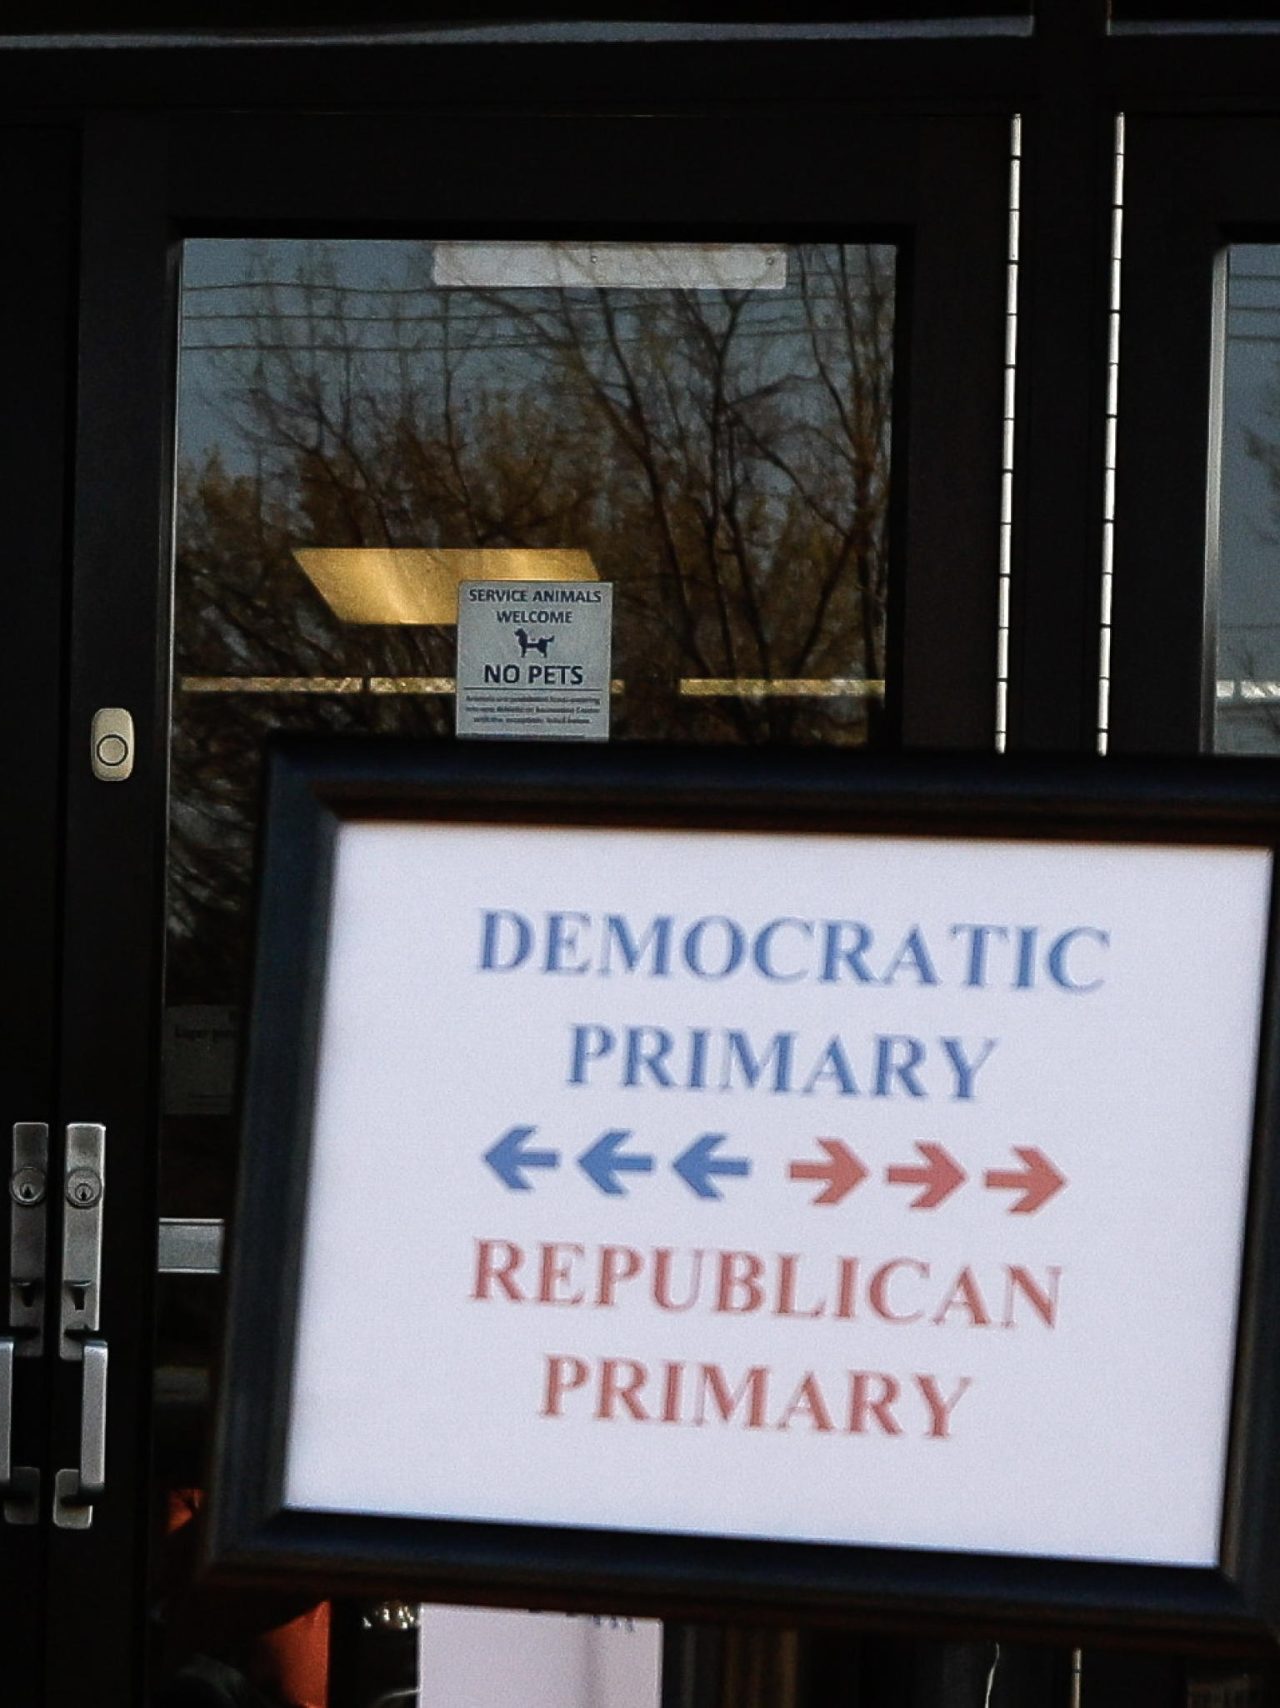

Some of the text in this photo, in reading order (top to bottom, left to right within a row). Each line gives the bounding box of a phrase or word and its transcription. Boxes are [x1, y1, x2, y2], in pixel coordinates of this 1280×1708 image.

[469, 588, 602, 603] SERVICE ANIMALS
[496, 610, 573, 624] WELCOME
[484, 665, 584, 685] NO PETS
[476, 908, 1112, 992] DEMOCRATIC
[567, 1022, 997, 1101] PRIMARY
[469, 1237, 1064, 1330] REPUBLICAN
[539, 1353, 972, 1439] PRIMARY
